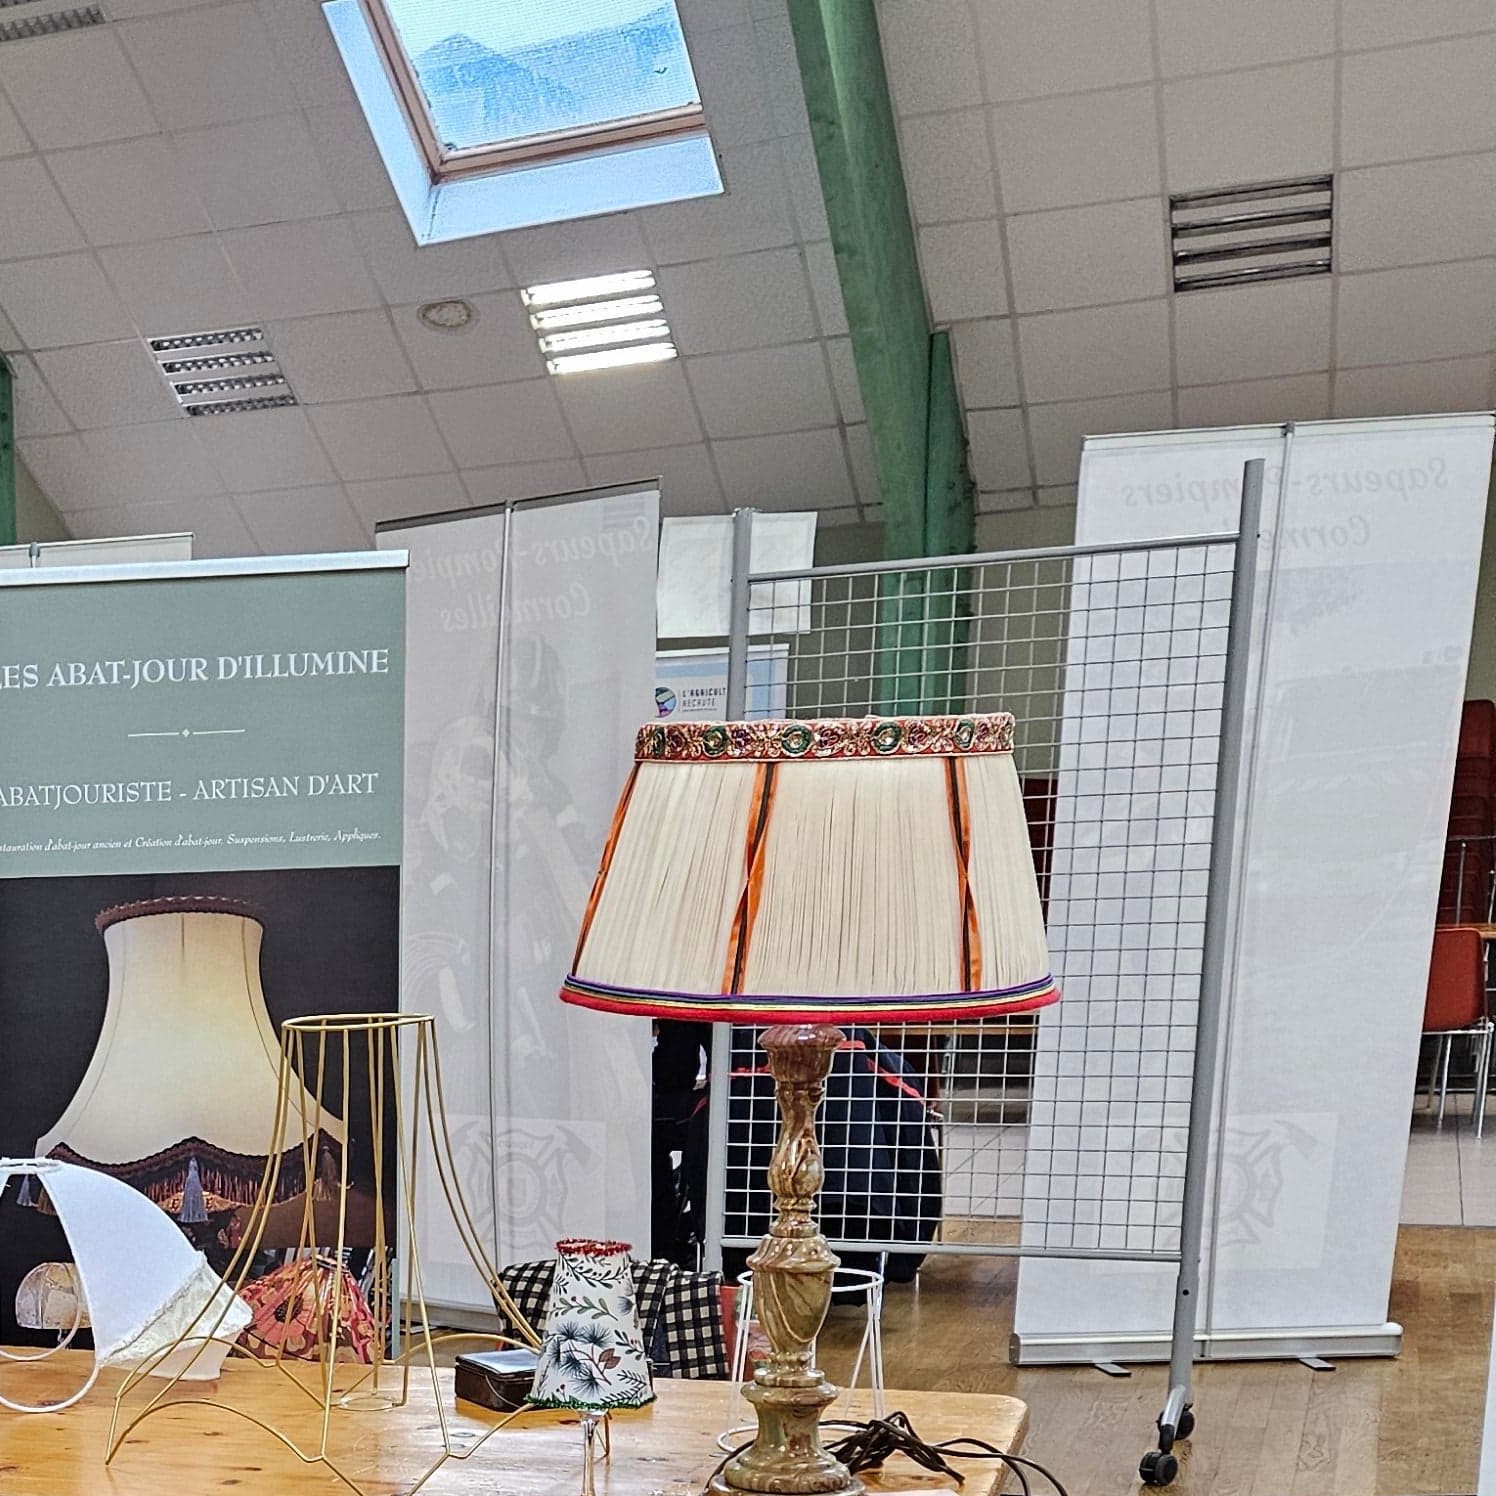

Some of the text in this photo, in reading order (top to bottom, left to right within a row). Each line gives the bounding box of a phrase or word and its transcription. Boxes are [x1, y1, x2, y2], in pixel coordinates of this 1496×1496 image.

[45, 657, 209, 689] ABAT-JOUR
[216, 648, 390, 681] D'ILLUMINE
[192, 775, 300, 801] ARTISAN
[307, 772, 379, 796] D'ART
